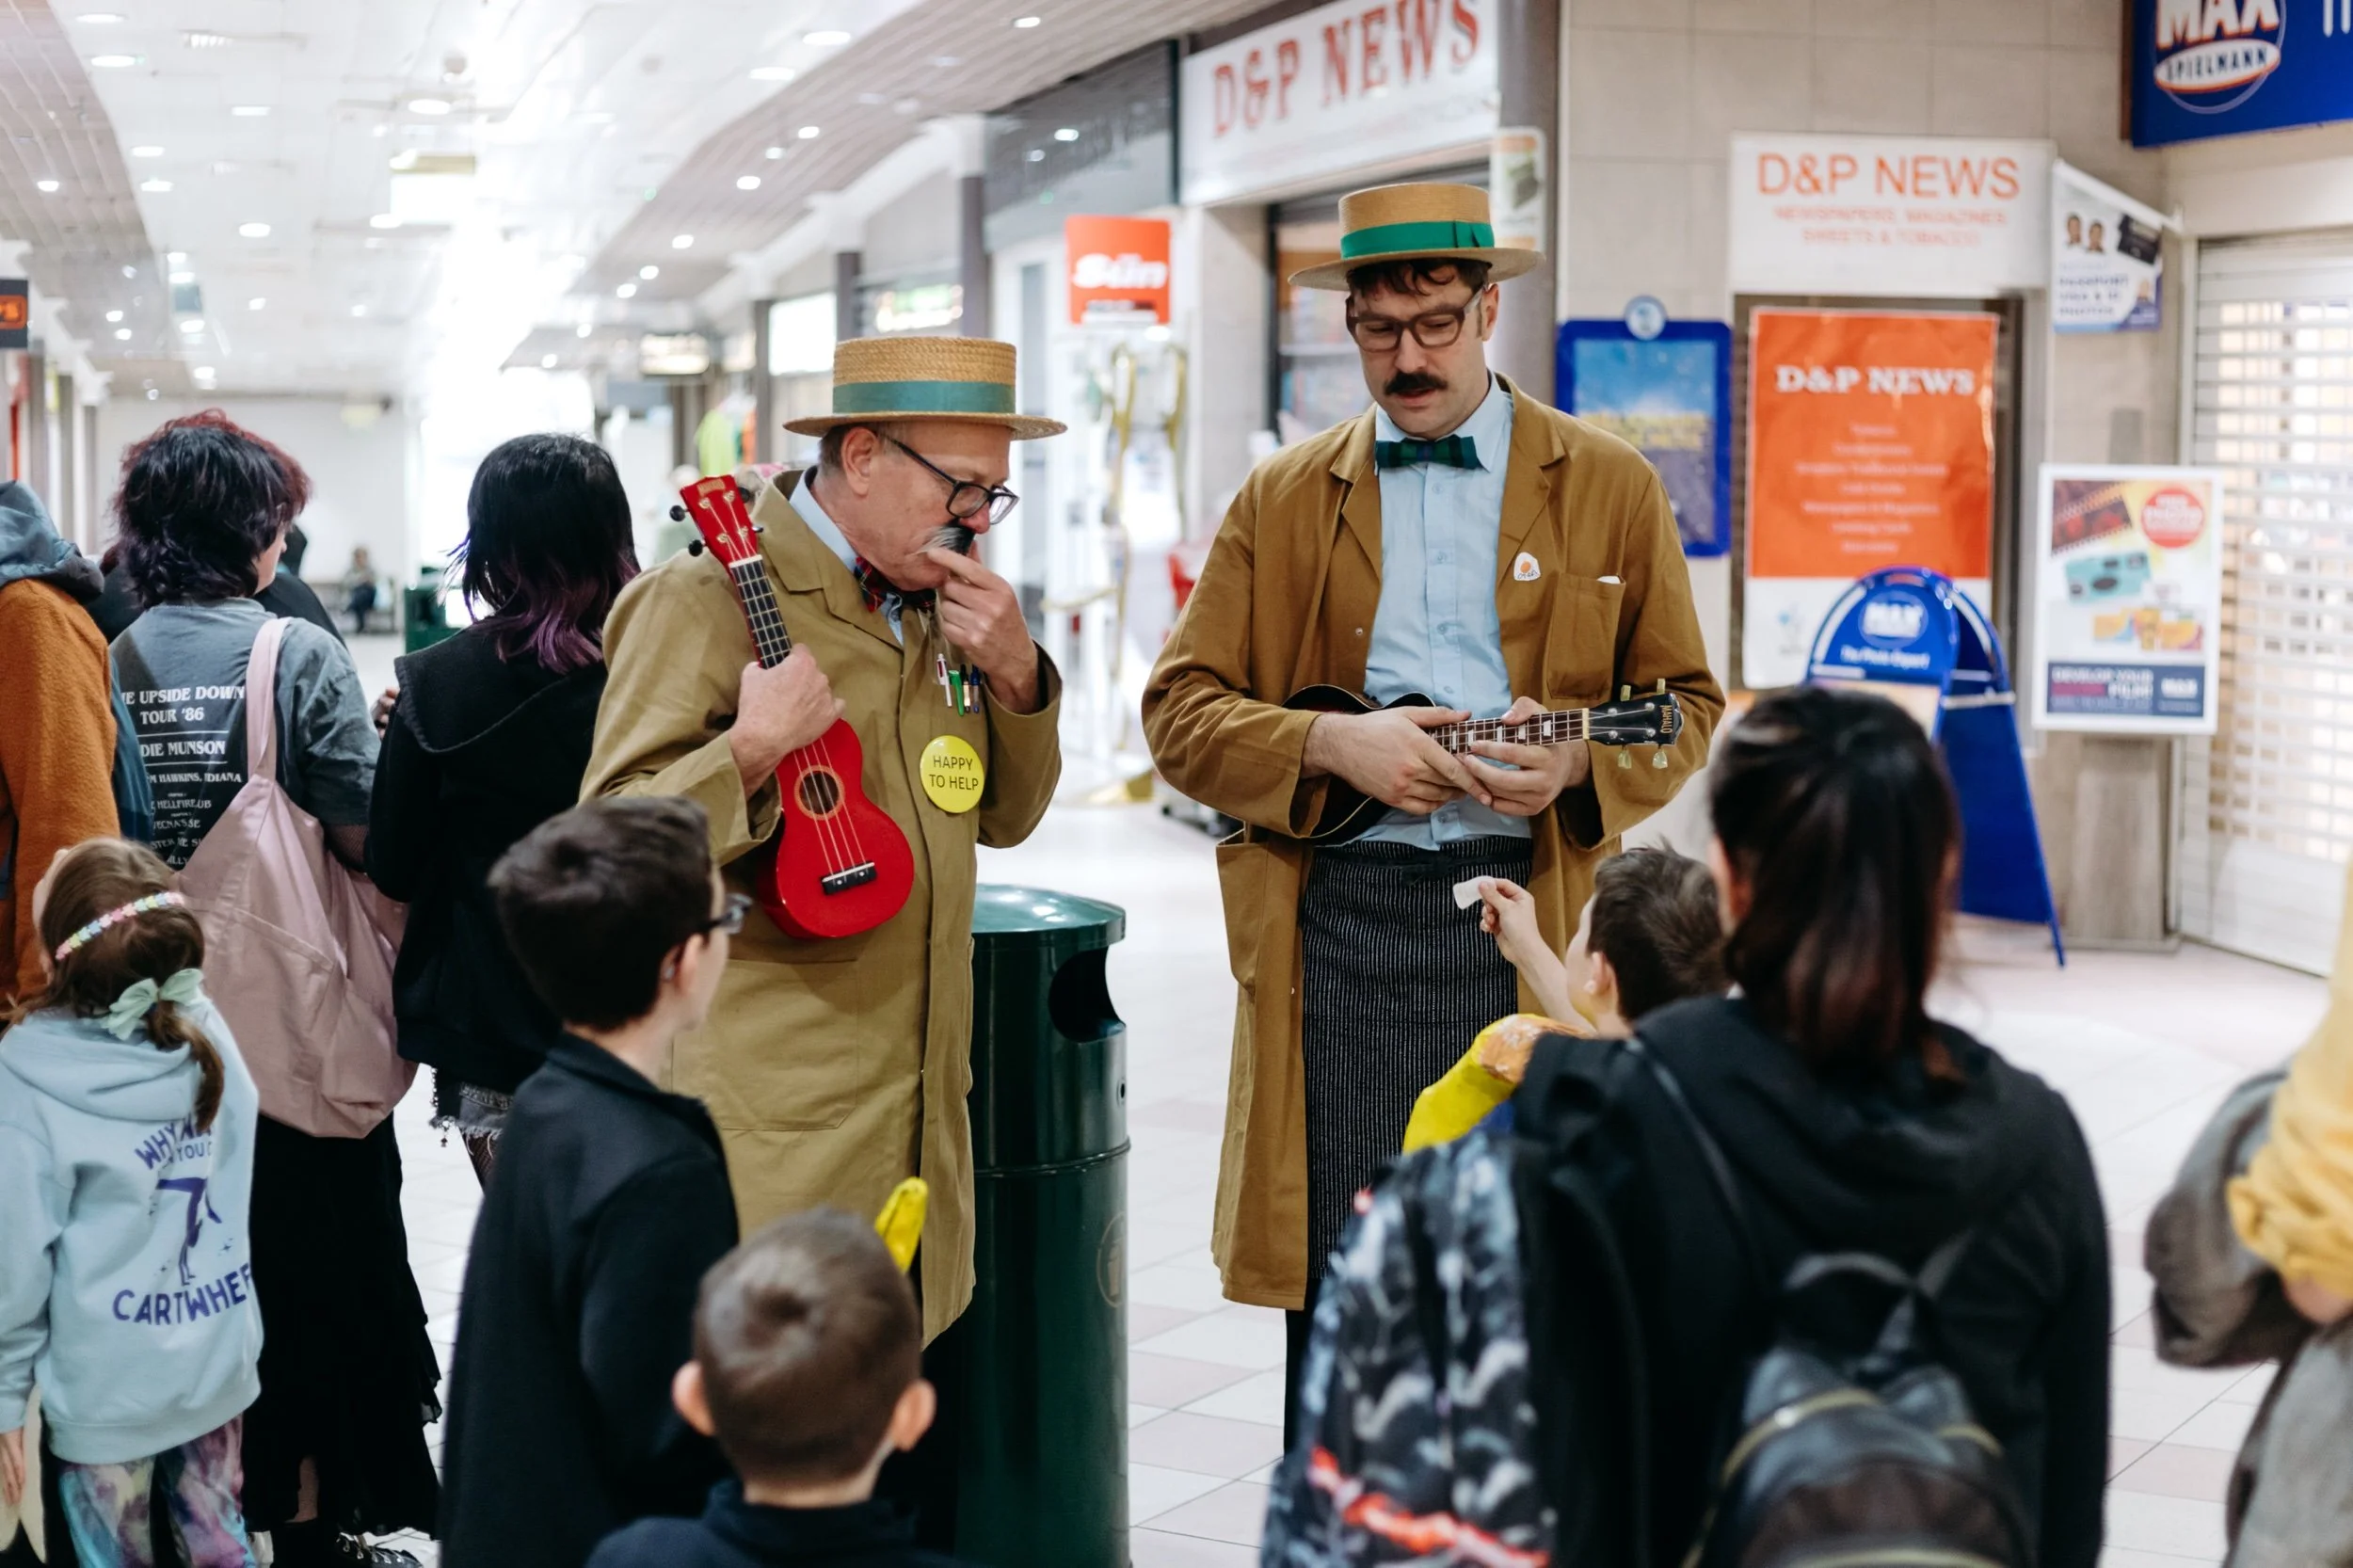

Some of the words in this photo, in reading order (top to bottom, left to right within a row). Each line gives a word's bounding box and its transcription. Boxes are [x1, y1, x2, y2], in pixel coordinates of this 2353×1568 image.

[1213, 38, 1302, 138] D&P
[1321, 0, 1480, 107] NEWS
[2167, 47, 2267, 82] SPIELMANN
[1756, 152, 1860, 196] D&P
[1874, 154, 2022, 200] NEWS
[1776, 364, 1861, 394] D&P
[1868, 366, 1975, 395] NEWS
[139, 687, 191, 704] UPSIDE
[195, 686, 245, 700] DOWN
[140, 709, 178, 725] TOUR
[182, 707, 205, 721] '86
[1660, 704, 1673, 733] MAHALO
[141, 743, 165, 757] DIE
[168, 741, 226, 756] MUNSON
[933, 755, 973, 771] HAPPY
[929, 774, 946, 788] TO
[949, 776, 979, 791] HELP
[176, 1143, 204, 1162] YOU
